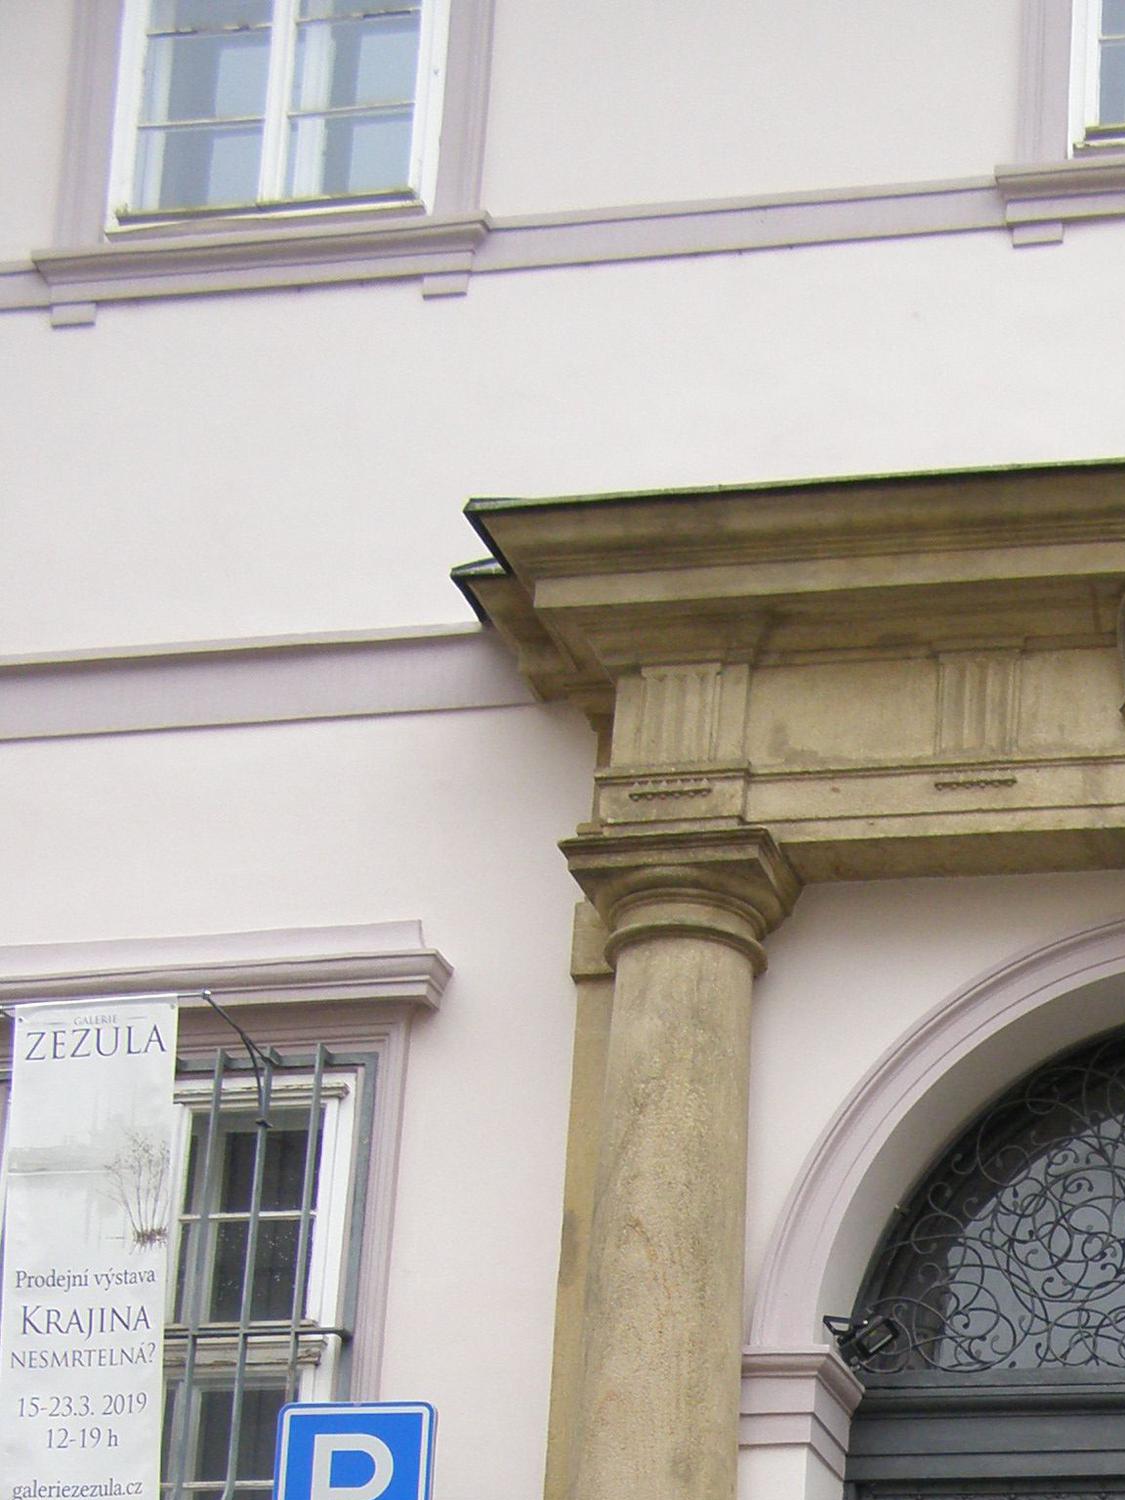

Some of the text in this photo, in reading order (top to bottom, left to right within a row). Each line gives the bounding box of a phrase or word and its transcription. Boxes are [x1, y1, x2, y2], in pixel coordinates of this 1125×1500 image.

[74, 1014, 118, 1026] GALERIE
[25, 1023, 166, 1061] ZEZULA
[16, 1268, 156, 1292] Prodejní výstava
[22, 1305, 151, 1341] KRAJINA
[11, 1342, 156, 1369] NESMRTELNÁ?
[18, 1392, 147, 1418] 15-23.3. 2019
[47, 1427, 119, 1449] 12-19 h
